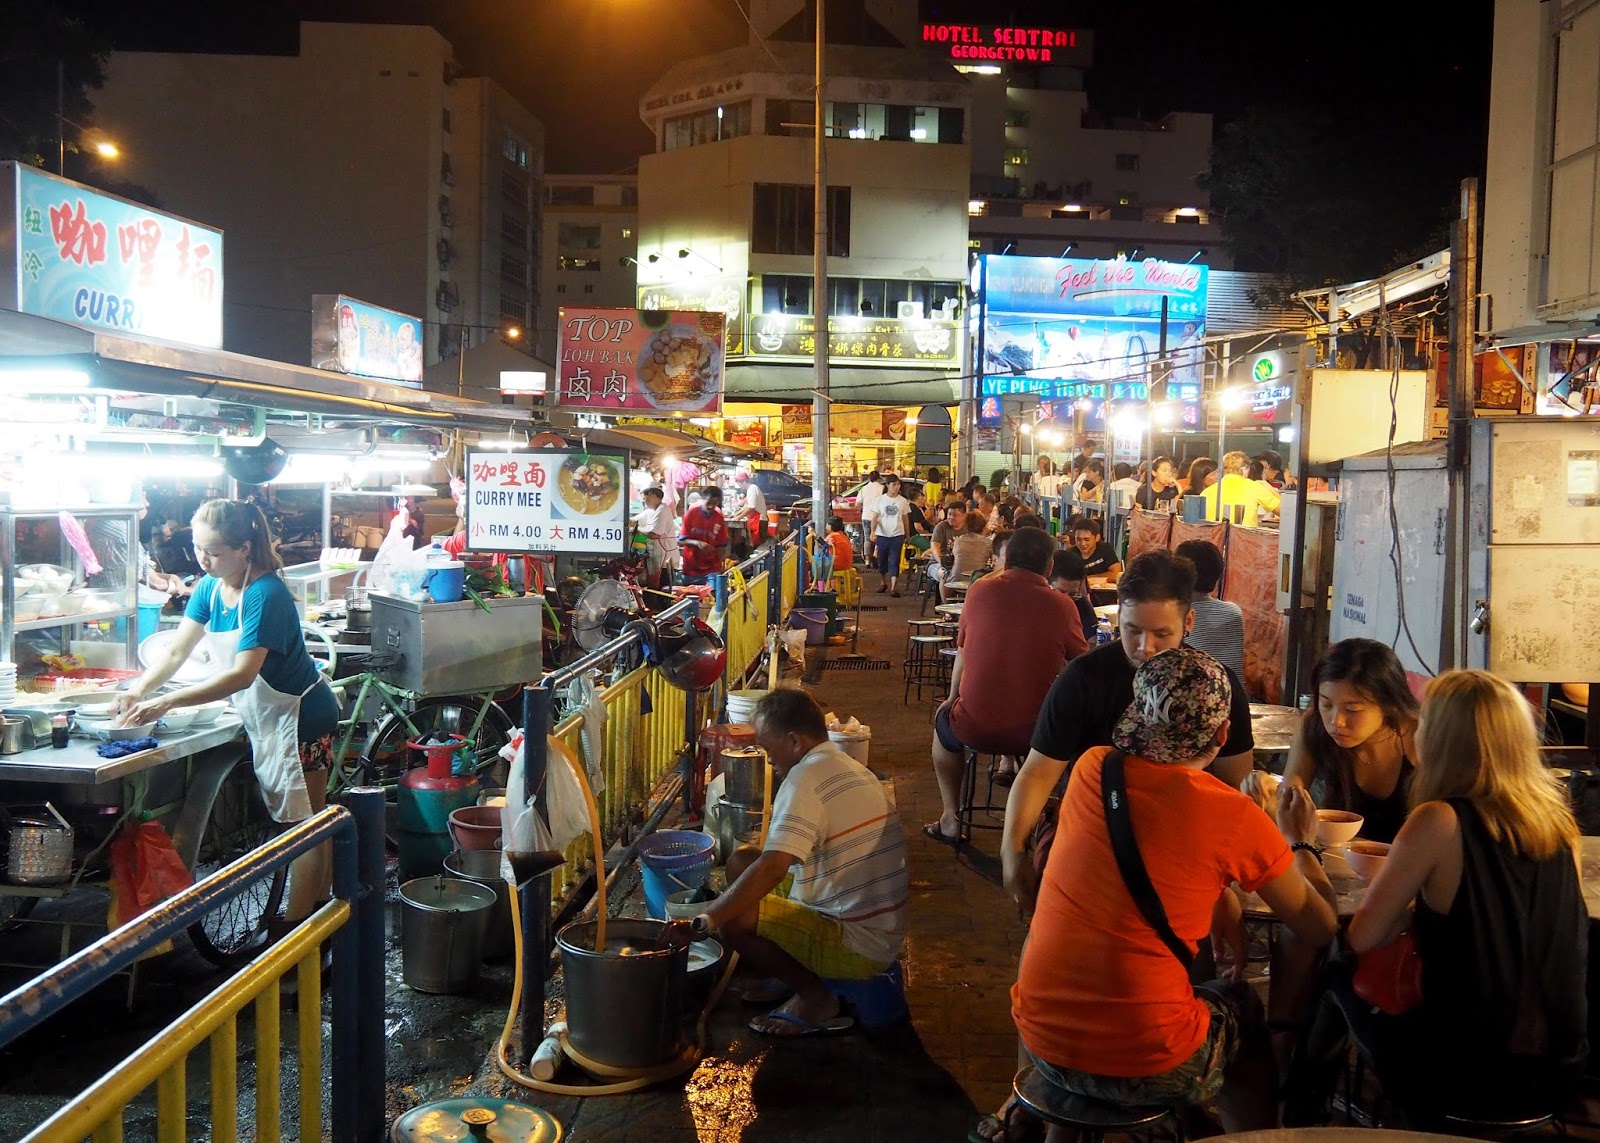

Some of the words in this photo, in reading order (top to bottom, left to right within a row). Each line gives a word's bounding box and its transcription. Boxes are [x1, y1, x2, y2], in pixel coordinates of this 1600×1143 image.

[923, 25, 983, 43] HOTEL
[951, 45, 1051, 61] GEORGETOWN
[1056, 262, 1098, 298] Feel
[1104, 256, 1135, 285] the
[1143, 259, 1199, 292] World
[567, 315, 634, 342] TOP
[562, 348, 597, 363] LOH
[599, 349, 637, 364] BAK
[567, 367, 628, 402] 卤肉
[473, 460, 546, 488] 咖哩面
[475, 490, 514, 506] CURRY
[517, 491, 542, 507] MEE
[471, 522, 485, 537] 小
[489, 524, 509, 537] RM
[513, 525, 541, 538] 4.00
[550, 525, 564, 540] 大
[568, 527, 588, 539] RM
[592, 528, 622, 540] 4.50
